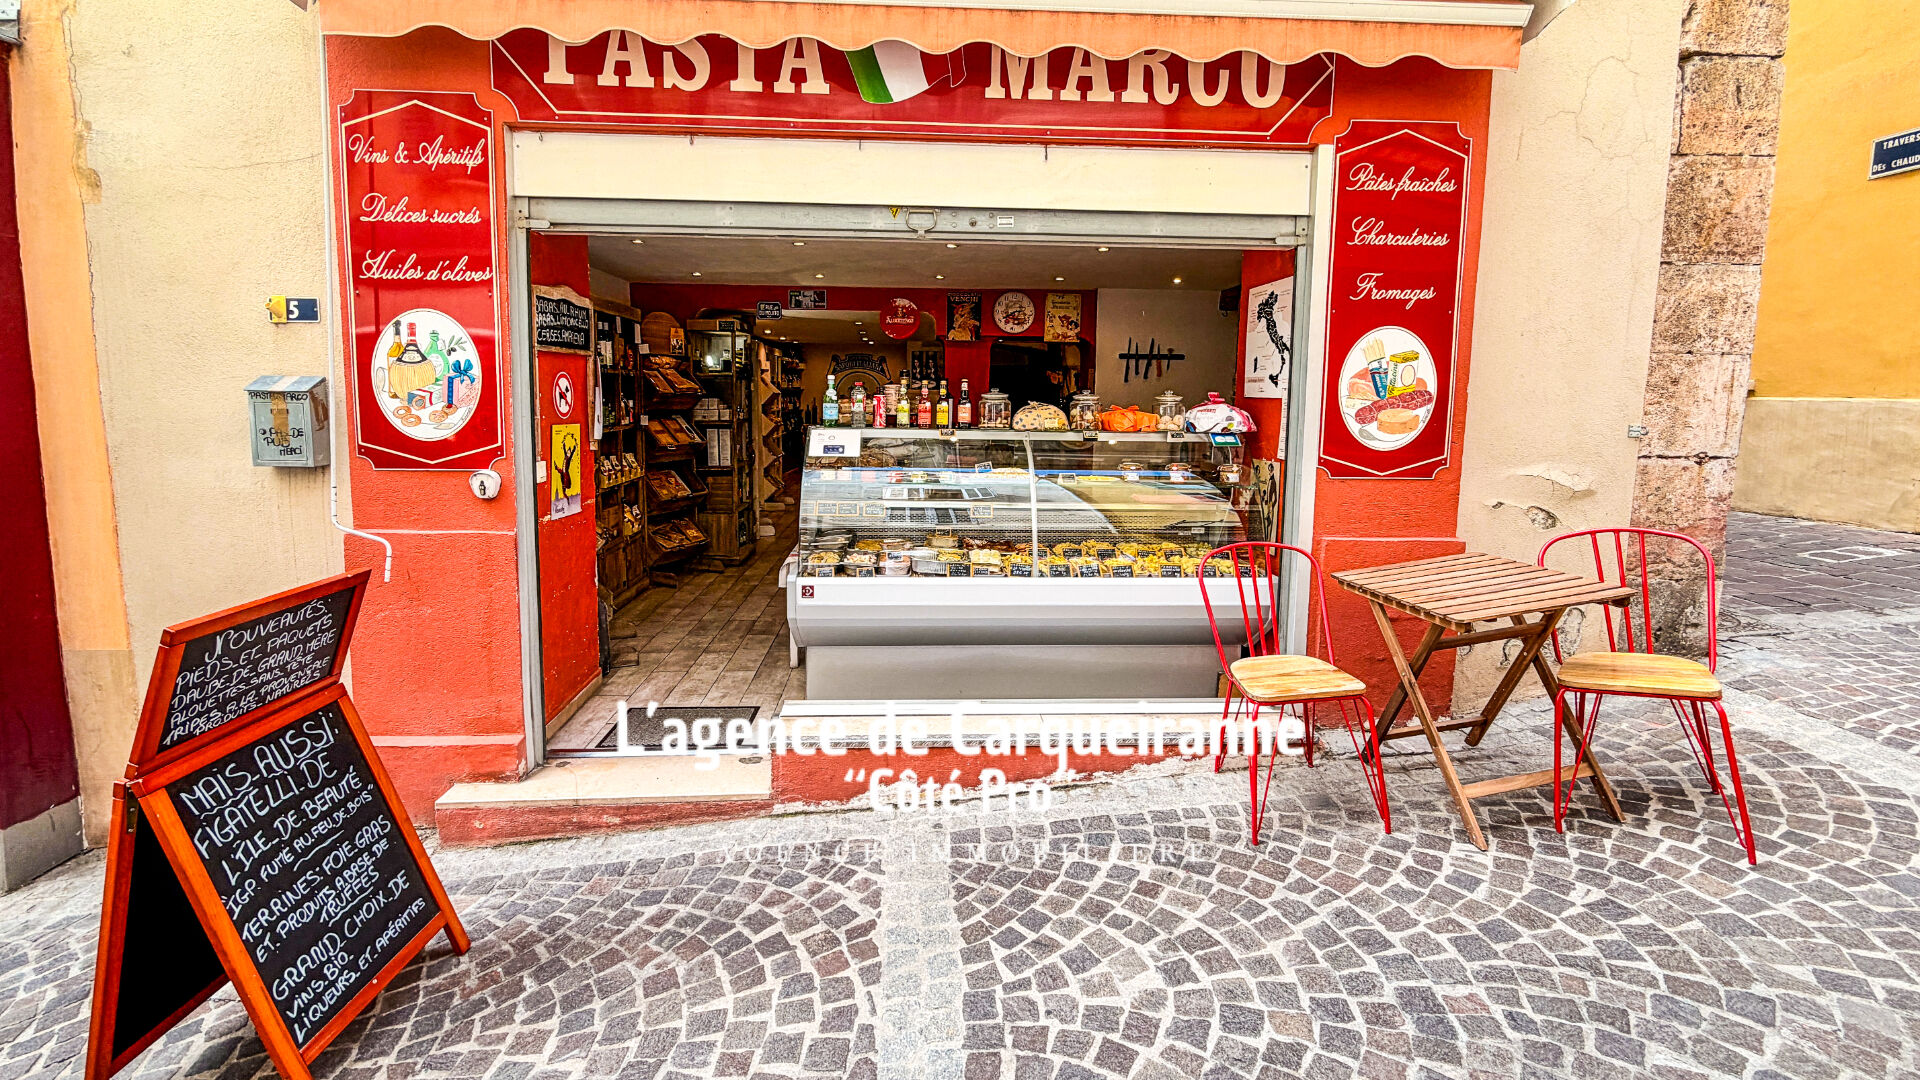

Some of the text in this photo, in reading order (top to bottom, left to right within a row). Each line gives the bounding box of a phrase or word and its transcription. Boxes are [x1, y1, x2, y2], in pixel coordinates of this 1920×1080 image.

[985, 42, 1286, 108] MARCO
[348, 134, 485, 175] Vins & Apéritifs
[1872, 163, 1886, 173] DES
[1346, 163, 1457, 201] Pâtes fraîches
[360, 192, 482, 225] Délices sucrés
[1347, 216, 1450, 247] Charcuteries
[359, 249, 493, 283] Huiles d'olives
[288, 300, 299, 319] 5
[1350, 272, 1437, 310] Fromages
[291, 427, 304, 438] DE
[176, 613, 333, 695] PIEDS ET PAQUETS
[171, 684, 246, 729] ALOUETTES
[251, 670, 279, 685] SANS
[172, 674, 227, 713] DAUBE
[233, 668, 251, 685] DE
[258, 645, 301, 673] GRAND
[163, 710, 222, 745] TRIPES
[180, 763, 253, 815] MAIS
[300, 752, 338, 789] DE
[274, 810, 301, 841] DE
[301, 765, 362, 820] BEAUTÉ
[293, 832, 312, 853] AU
[311, 817, 333, 841] FEU
[332, 809, 348, 828] DE
[322, 842, 352, 875] FOIE
[354, 815, 391, 850] GRAS
[256, 932, 274, 963] ET
[276, 886, 336, 939] PRODUITS
[344, 856, 373, 881] BASE
[372, 839, 390, 858] DE
[320, 866, 379, 922] TRUFFES
[272, 870, 410, 1000] GRAND CHOIX DE
[293, 970, 356, 1044] LIQUEURS
[359, 945, 372, 970] ET
